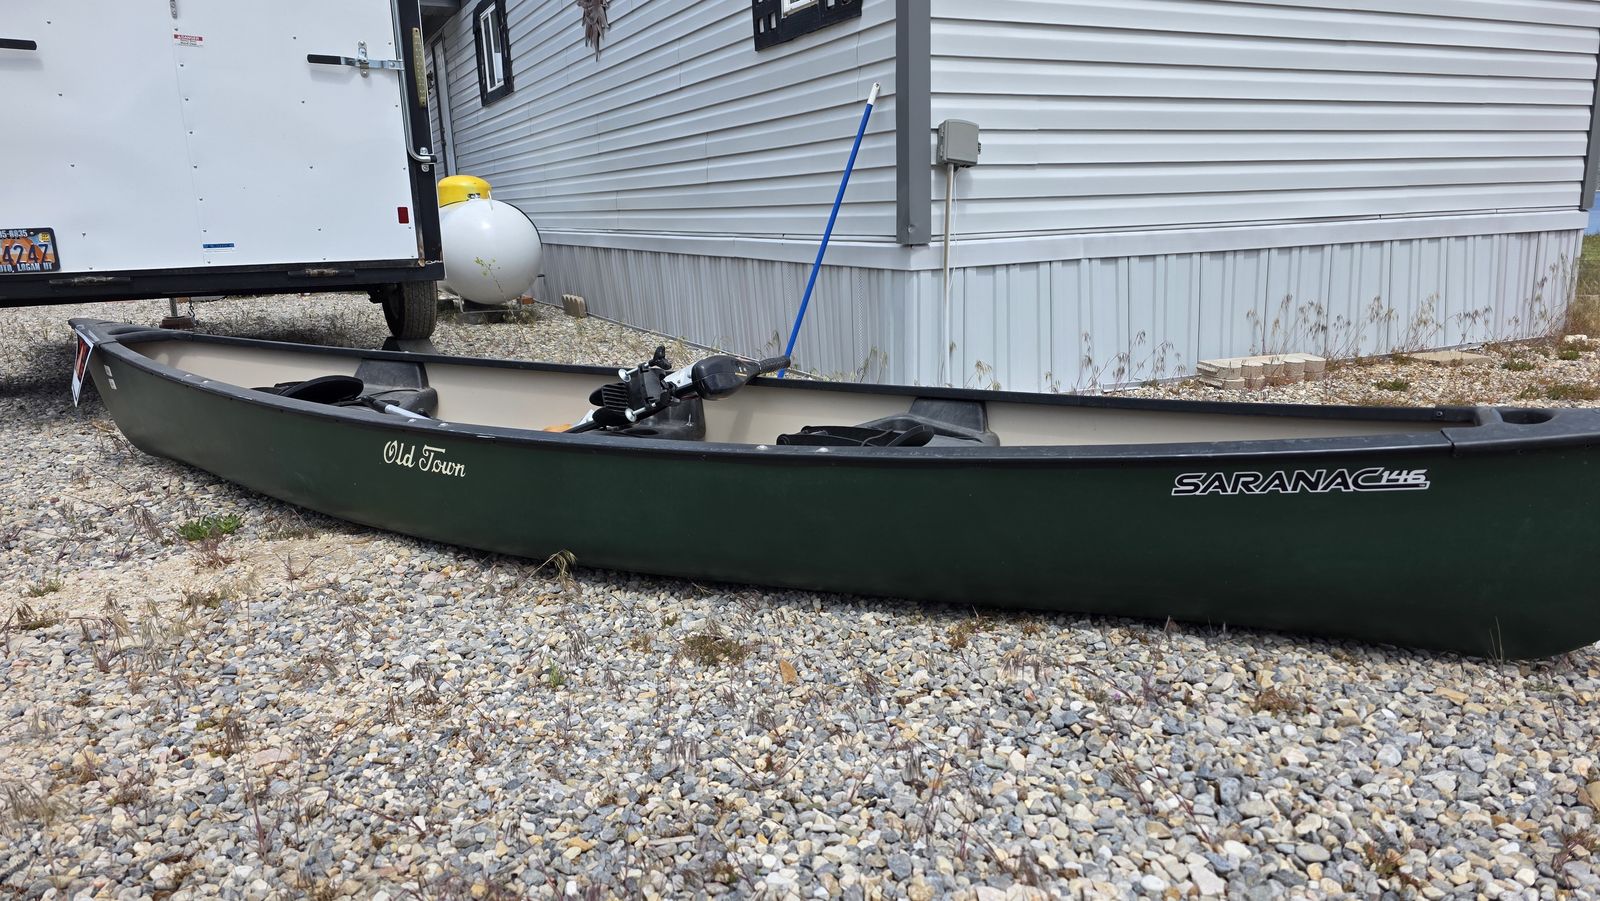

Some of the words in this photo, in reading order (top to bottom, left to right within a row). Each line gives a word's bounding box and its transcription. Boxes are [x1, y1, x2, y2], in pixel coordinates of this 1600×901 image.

[16, 262, 41, 271] LOGAN
[383, 439, 415, 468] Old
[418, 444, 466, 478] Town
[1171, 466, 1385, 496] SARANAC
[1381, 469, 1428, 484] 146
